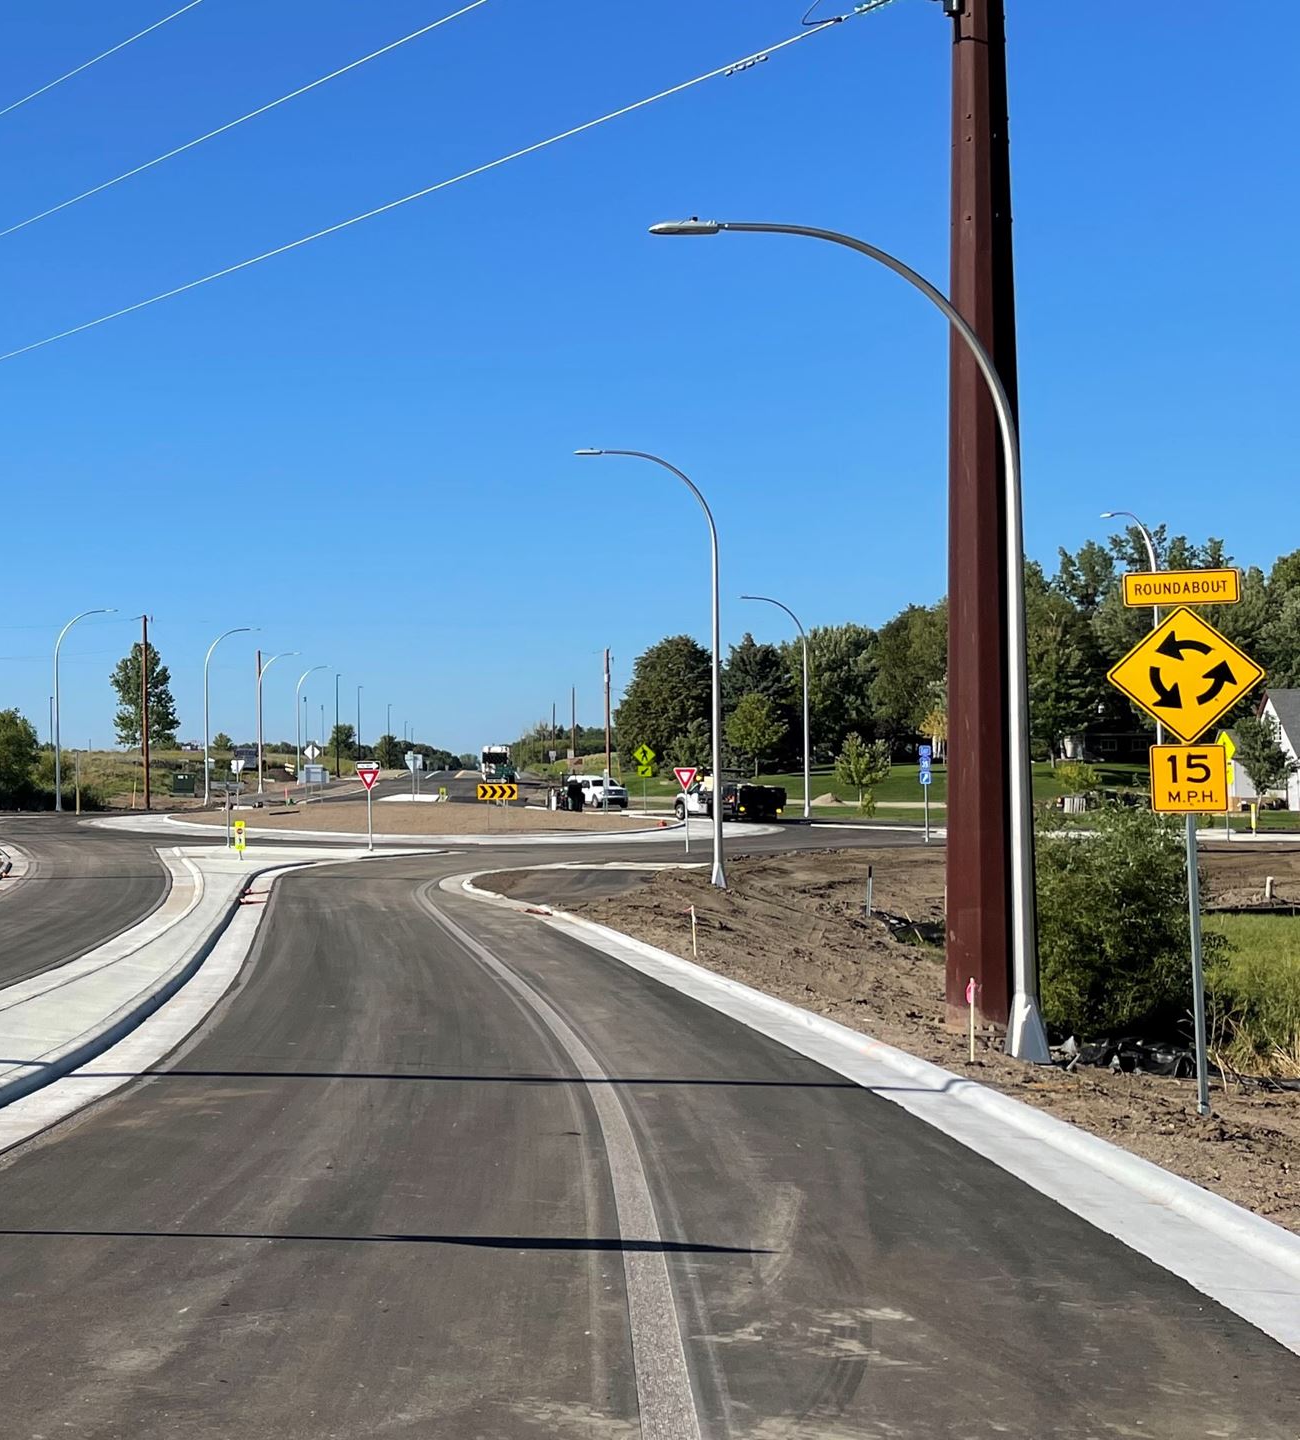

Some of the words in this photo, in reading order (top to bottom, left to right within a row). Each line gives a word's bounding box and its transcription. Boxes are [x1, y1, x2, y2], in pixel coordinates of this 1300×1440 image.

[1134, 580, 1227, 596] ROUNDABOUT
[1167, 754, 1211, 783] 15
[1168, 790, 1218, 803] M.P.H.
